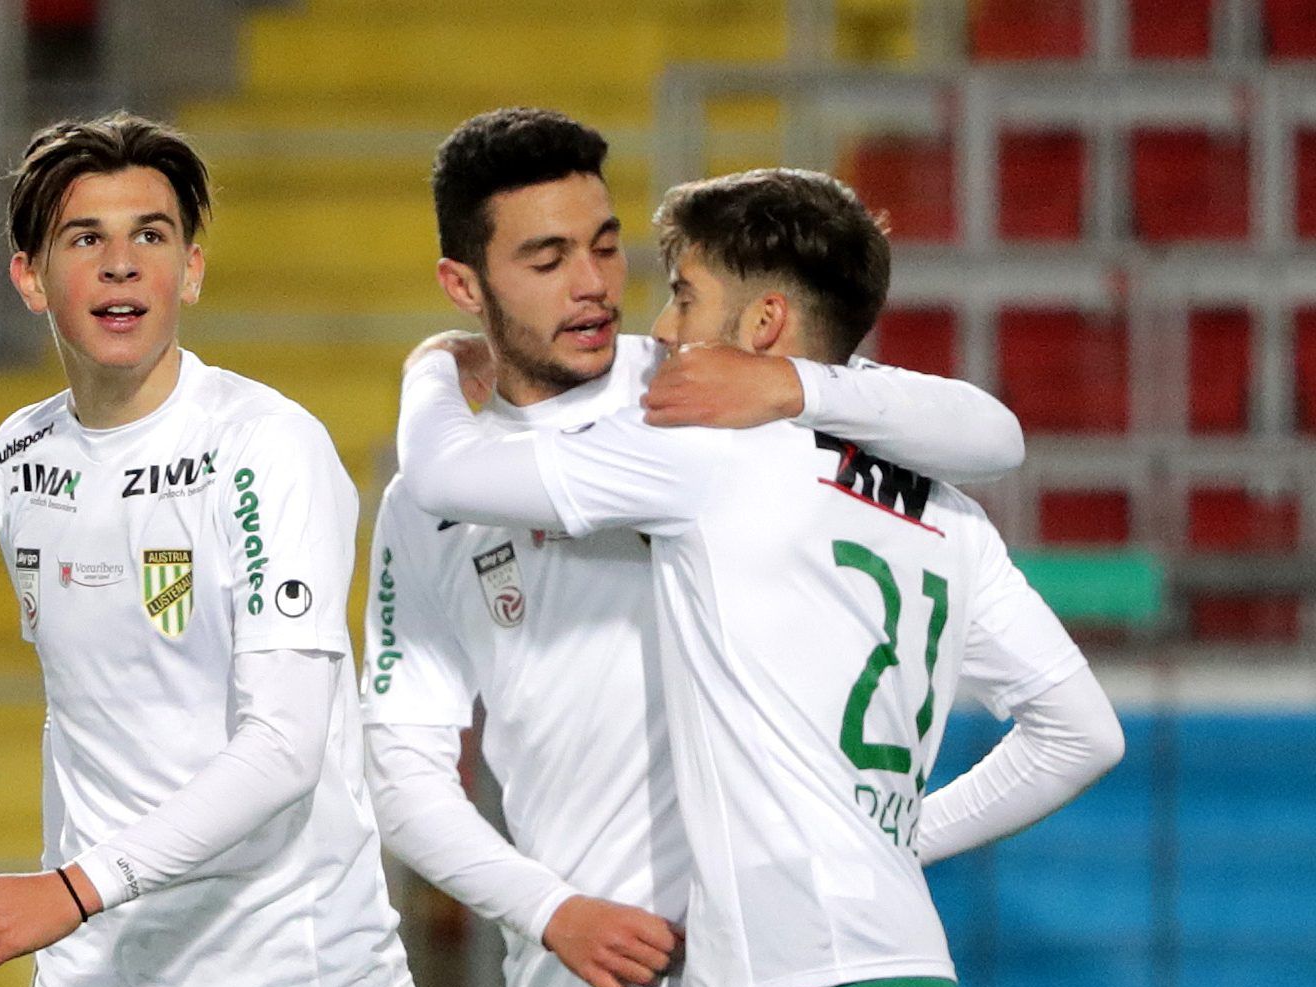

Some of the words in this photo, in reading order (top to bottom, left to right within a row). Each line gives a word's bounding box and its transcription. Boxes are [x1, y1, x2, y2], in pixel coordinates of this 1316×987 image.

[122, 447, 219, 498] ZIMA
[74, 561, 124, 577] Vorarlberg
[148, 551, 190, 562] AUSTRIA
[832, 539, 949, 795] 21
